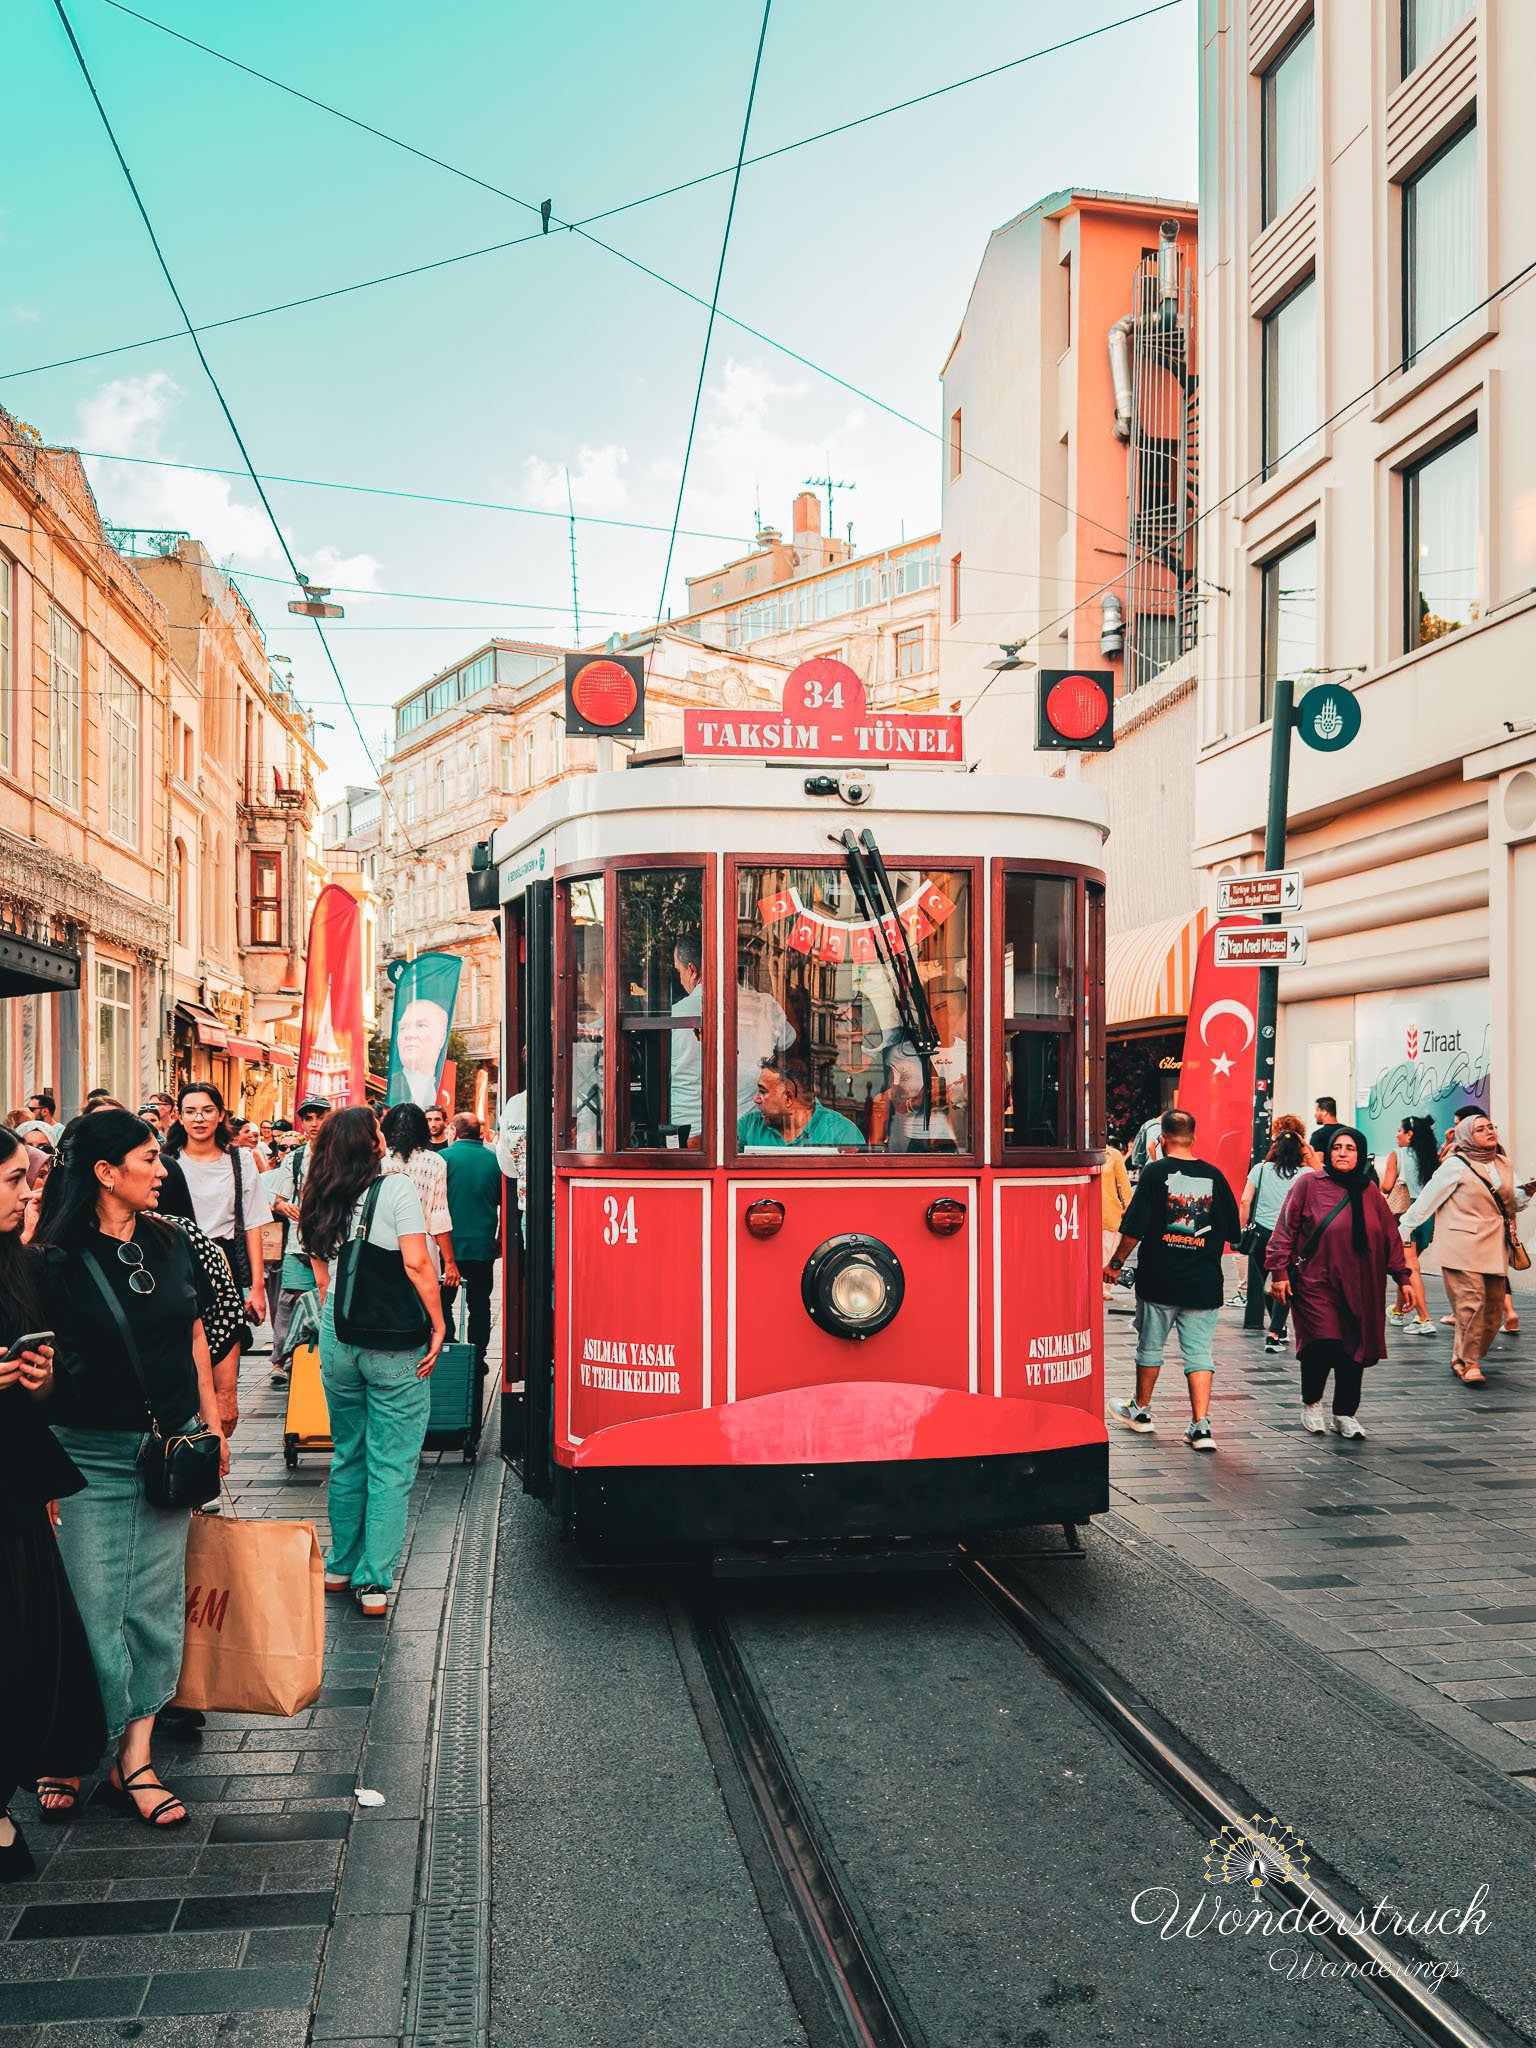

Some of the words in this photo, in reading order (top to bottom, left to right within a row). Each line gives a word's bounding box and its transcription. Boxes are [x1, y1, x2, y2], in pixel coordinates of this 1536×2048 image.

[803, 680, 845, 709] 34
[697, 717, 820, 750] TAKSİM
[853, 719, 955, 753] TÜNEL
[1228, 939, 1243, 957] Yapı
[1243, 938, 1261, 954] Kredi
[1261, 937, 1287, 953] Müzesi
[1422, 1029, 1462, 1053] Ziraat
[1257, 1080, 1265, 1091] 2
[603, 1196, 638, 1245] 34
[1054, 1193, 1080, 1241] 34
[583, 1338, 628, 1366] ASILMAK
[629, 1343, 676, 1367] YASAK
[1029, 1333, 1075, 1359] ASILMAK
[580, 1363, 591, 1387] VE
[592, 1367, 681, 1395] TEHLIKELIDIR
[1025, 1364, 1042, 1386] VE
